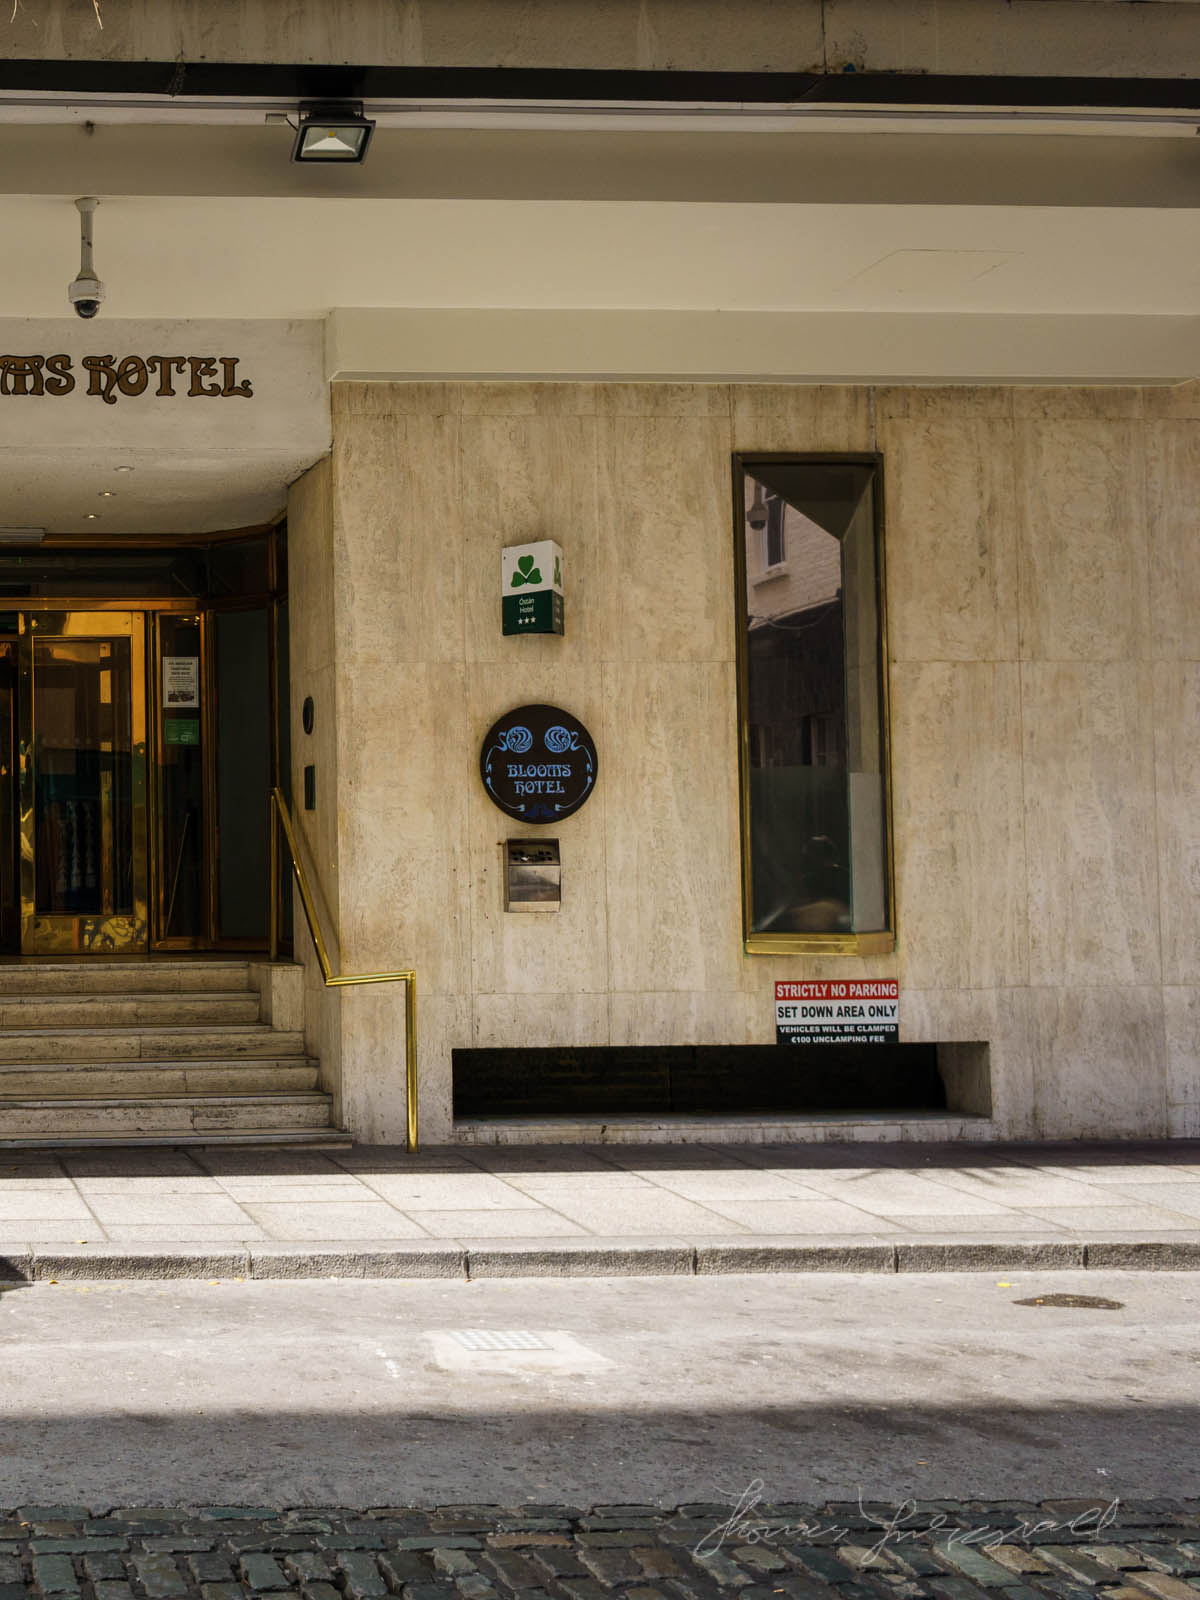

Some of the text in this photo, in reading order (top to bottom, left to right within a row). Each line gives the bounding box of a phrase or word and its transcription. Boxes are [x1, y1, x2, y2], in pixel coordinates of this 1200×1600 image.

[82, 354, 254, 404] HOTEL
[519, 605, 534, 613] Hotel
[507, 764, 571, 778] BLOOMS
[514, 780, 566, 796] HOTEL
[777, 984, 897, 997] STRICTLY NO PARKING
[777, 1005, 896, 1018] SET DOWN AREA ONLY
